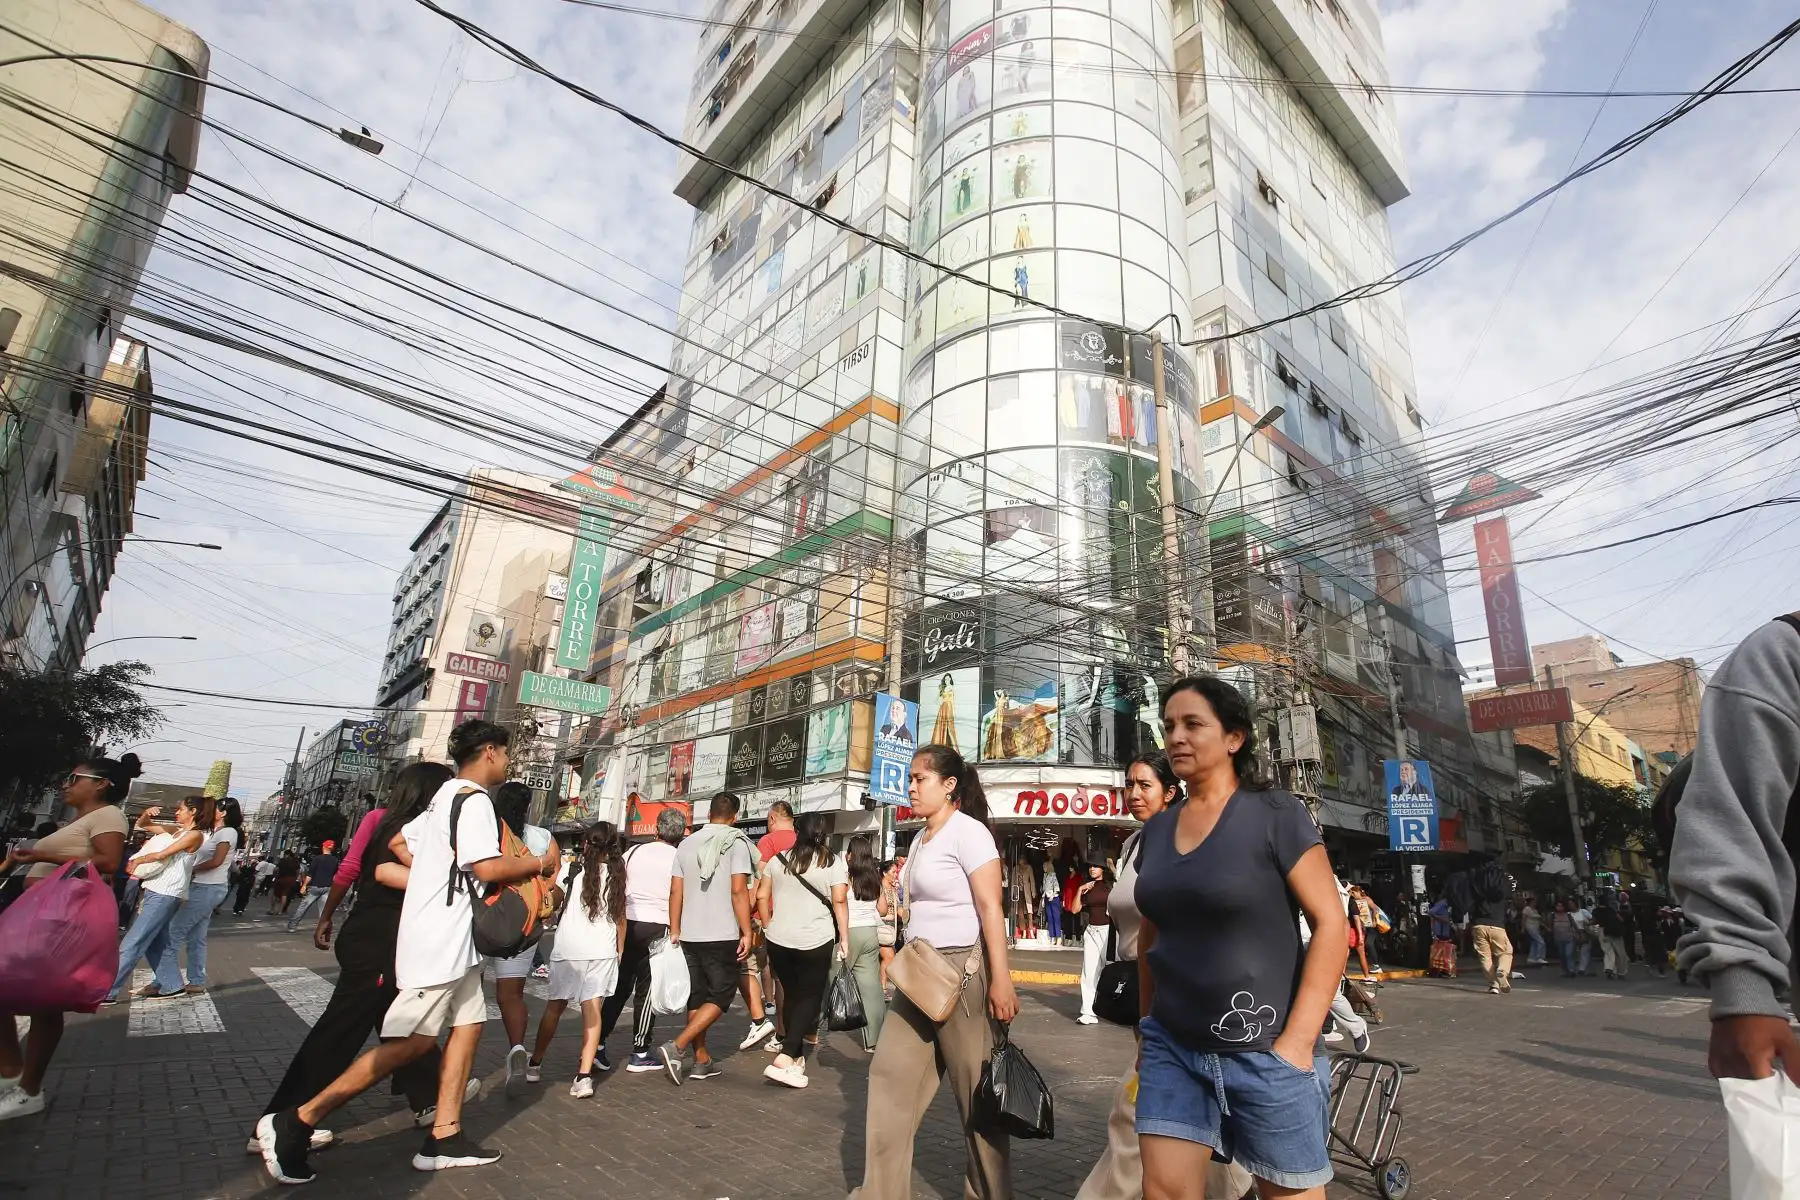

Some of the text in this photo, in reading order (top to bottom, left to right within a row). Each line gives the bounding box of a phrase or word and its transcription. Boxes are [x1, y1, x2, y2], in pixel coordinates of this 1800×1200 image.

[843, 344, 869, 372] TIRSO
[1481, 526, 1503, 566] LA
[565, 562, 596, 660] TORRE
[927, 609, 976, 624] CREACIONES
[1487, 572, 1517, 671] TORRE
[449, 655, 507, 680] GALERIA
[530, 675, 602, 703] DE GAMARRA
[1479, 693, 1558, 719] DE GAMARRA
[354, 721, 387, 743] CENTRO
[878, 731, 914, 749] RAFAEL
[876, 750, 912, 763] PRESIDENTE
[522, 776, 552, 789] 1560
[883, 762, 902, 792] R
[883, 793, 908, 804] VICTORIA
[1391, 794, 1432, 802] RAFAEL
[1402, 819, 1427, 842] R
